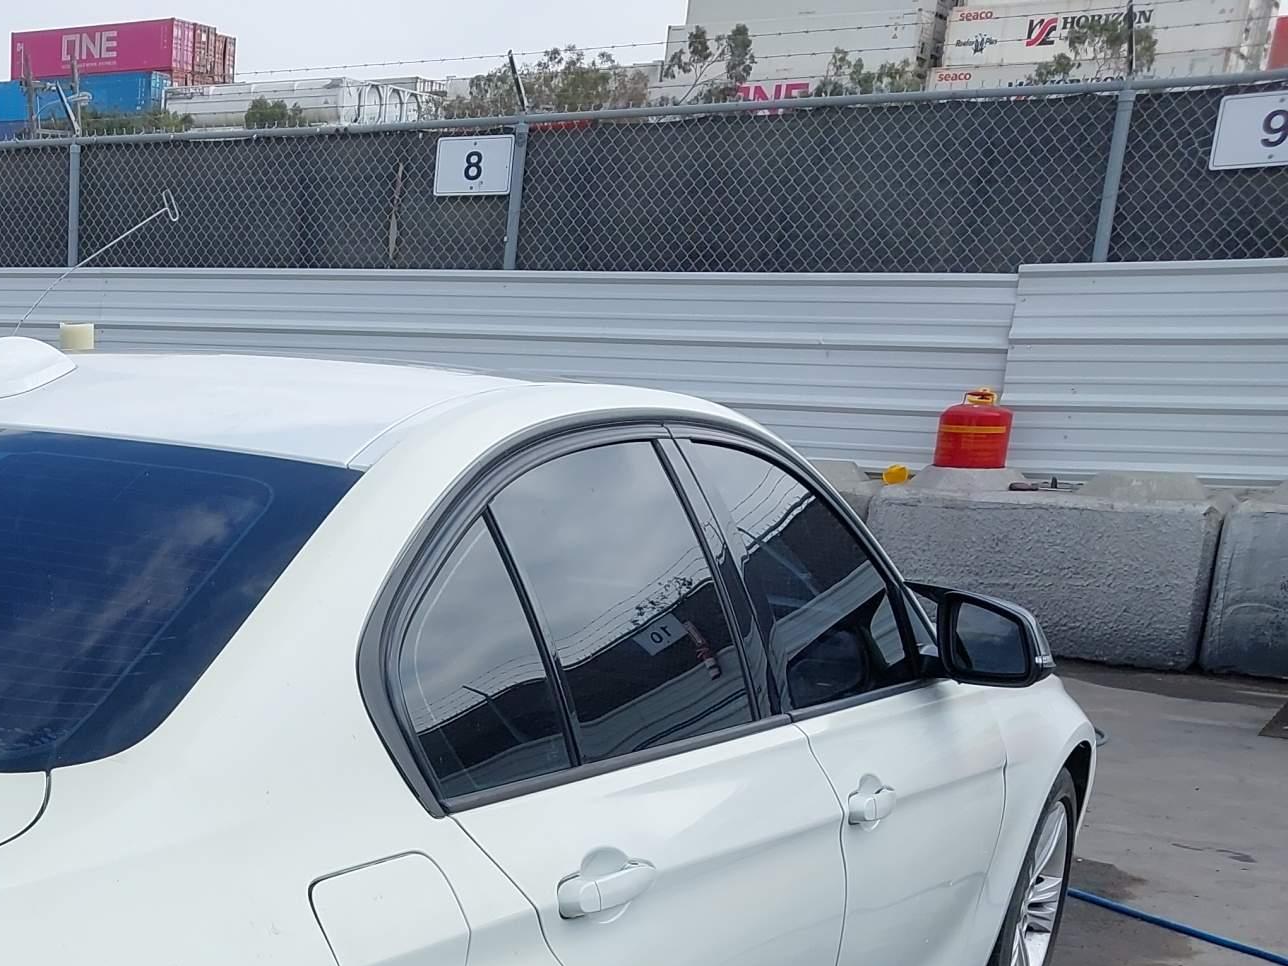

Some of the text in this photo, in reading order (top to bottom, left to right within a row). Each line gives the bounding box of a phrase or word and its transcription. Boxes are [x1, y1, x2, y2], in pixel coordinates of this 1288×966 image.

[959, 10, 993, 21] seaco
[62, 31, 118, 61] ONE
[938, 72, 972, 82] seaco
[1260, 109, 1288, 148] 9
[464, 150, 483, 181] 8
